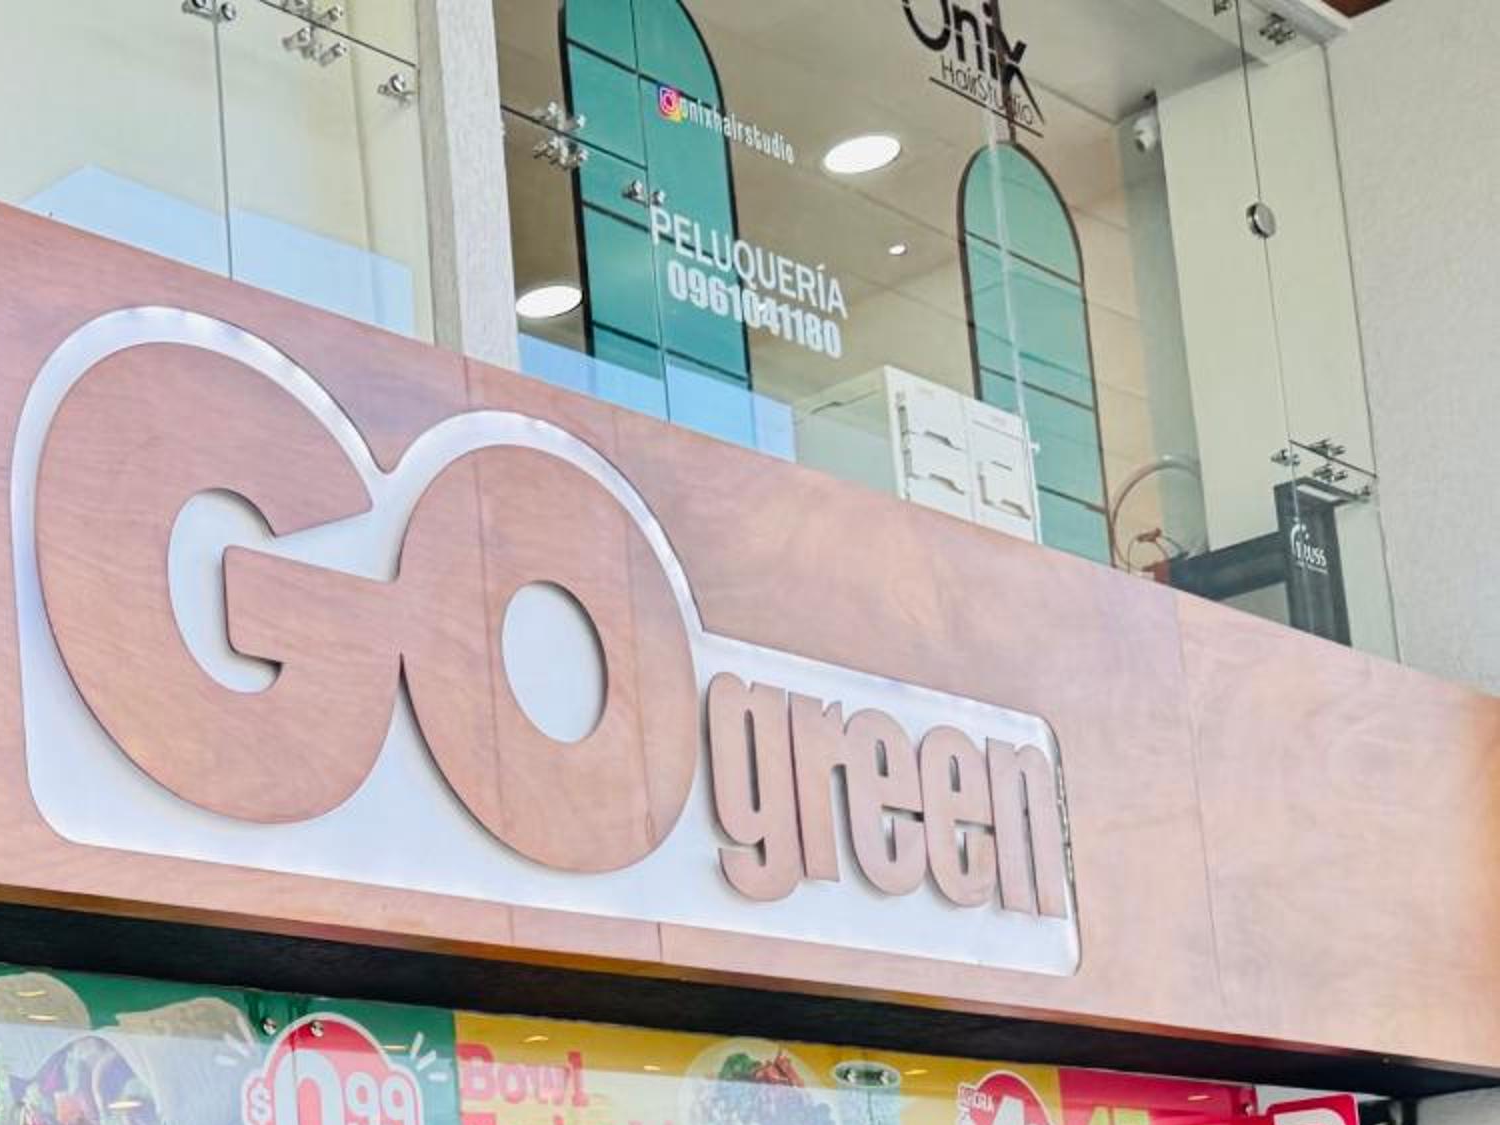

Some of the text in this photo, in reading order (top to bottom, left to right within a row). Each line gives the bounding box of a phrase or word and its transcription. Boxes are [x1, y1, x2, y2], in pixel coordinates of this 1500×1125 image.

[650, 205, 848, 319] PELUQUERÍA
[667, 259, 843, 359] 0961041180
[34, 340, 1069, 920] GO green
[456, 1043, 590, 1107] Bowl
